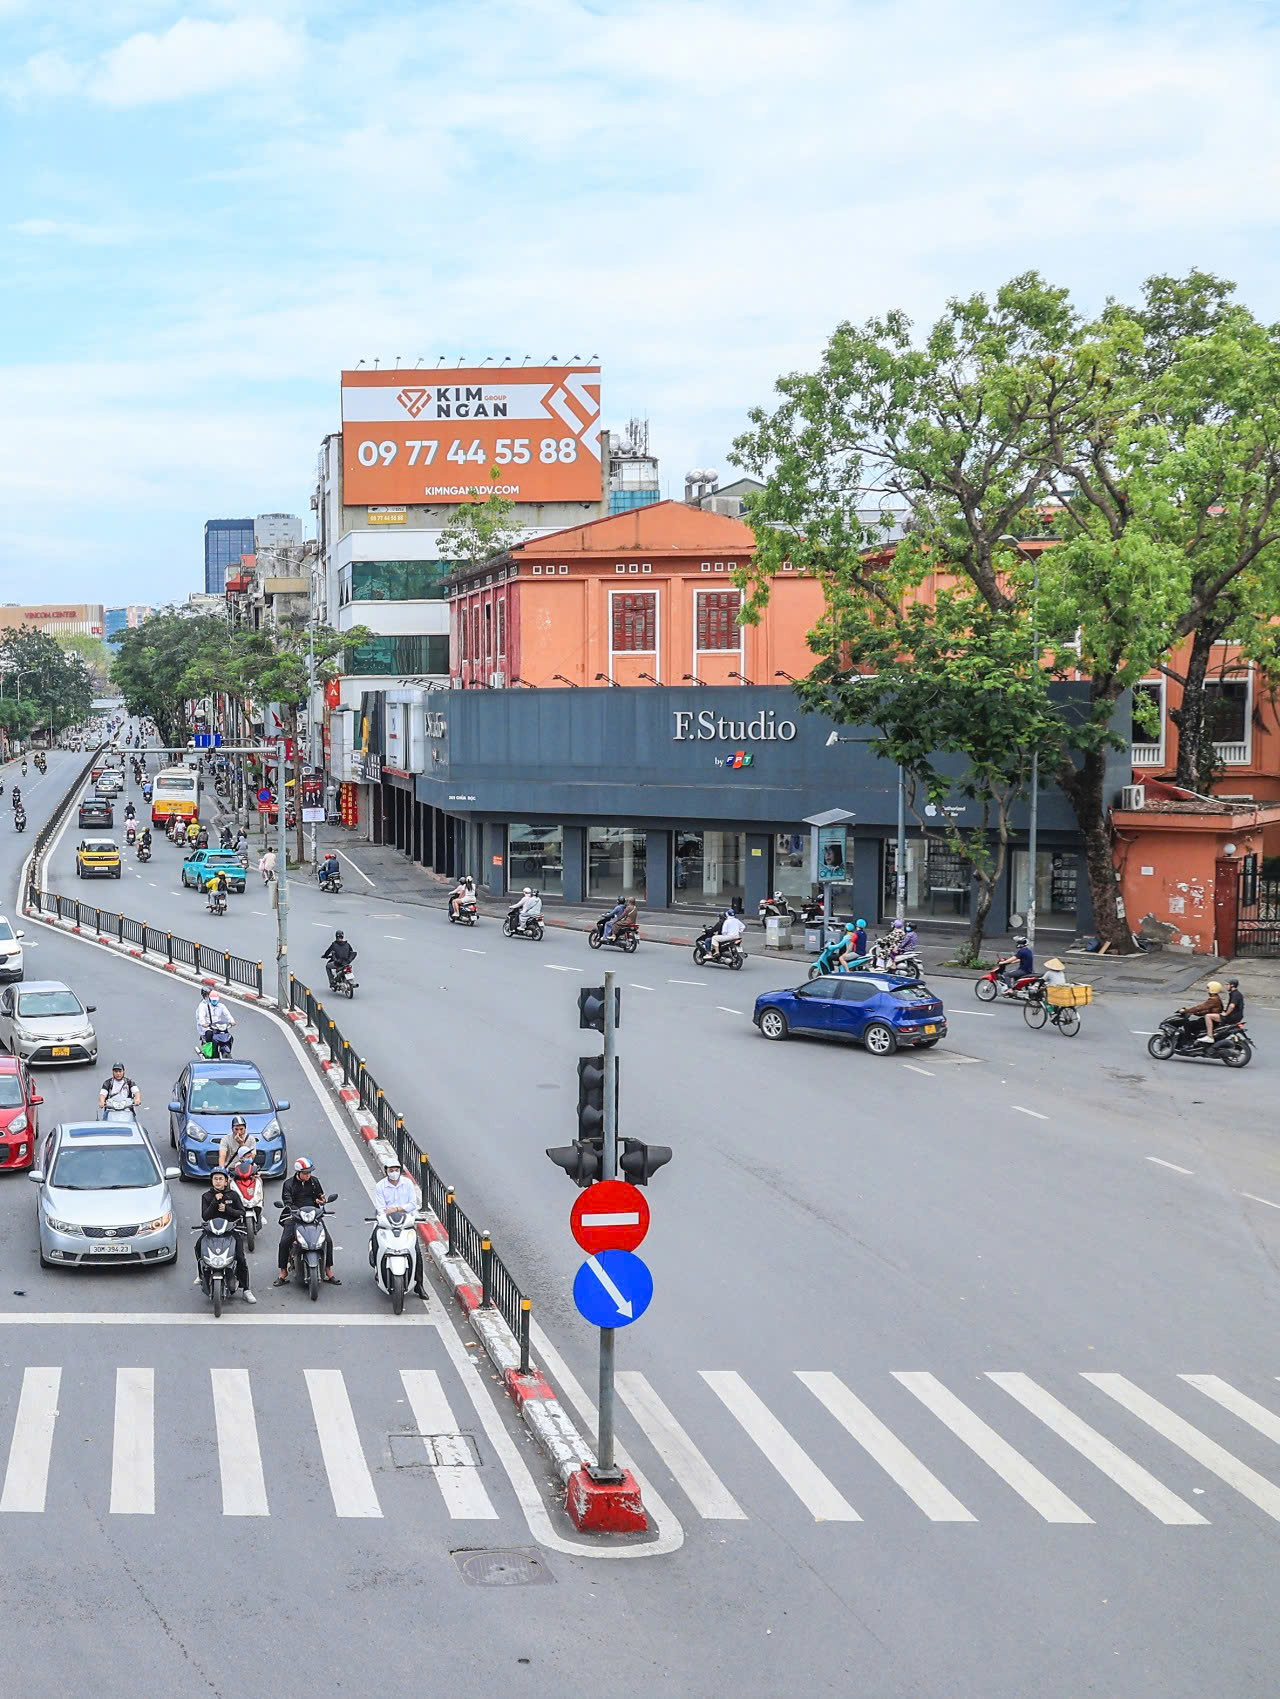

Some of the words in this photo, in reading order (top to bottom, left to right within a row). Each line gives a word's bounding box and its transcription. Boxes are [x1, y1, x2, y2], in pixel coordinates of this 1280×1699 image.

[436, 387, 483, 402] KIM
[436, 402, 508, 418] NGAN
[357, 440, 398, 467] 09
[405, 440, 439, 466] 77
[446, 439, 487, 465] 44
[494, 438, 531, 465] 55
[539, 438, 577, 464] 88
[673, 710, 798, 742] F.Studio
[714, 757, 724, 768] by
